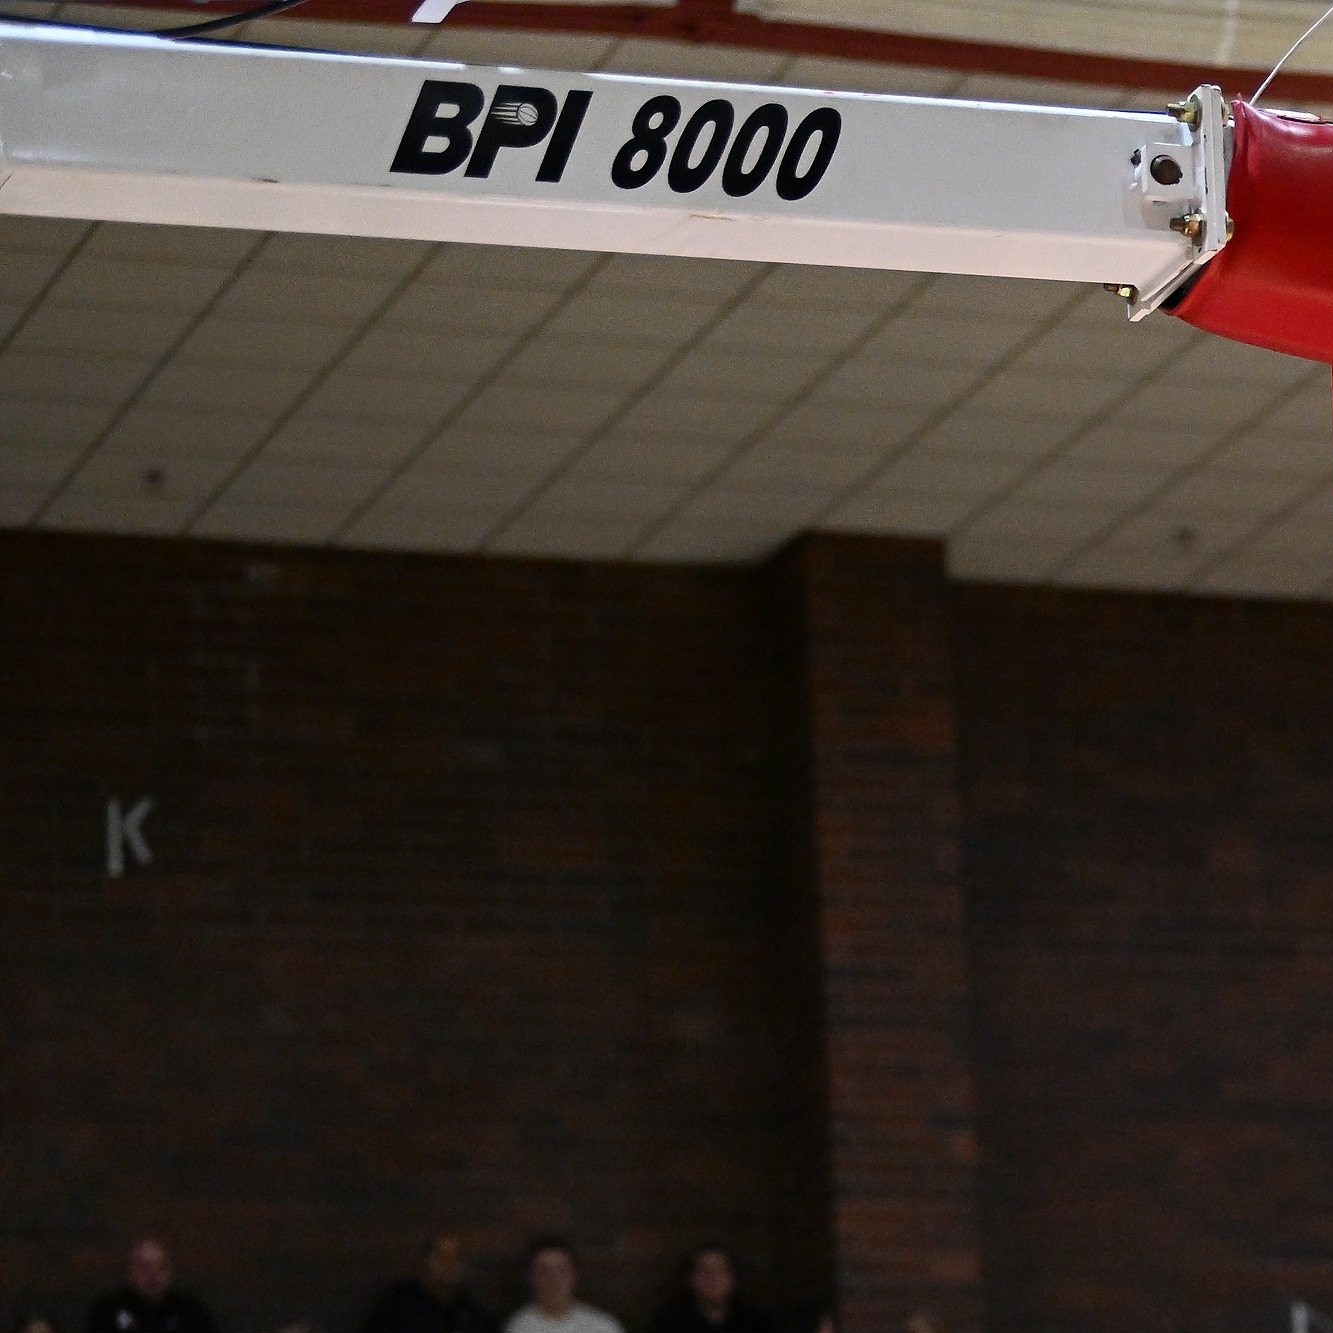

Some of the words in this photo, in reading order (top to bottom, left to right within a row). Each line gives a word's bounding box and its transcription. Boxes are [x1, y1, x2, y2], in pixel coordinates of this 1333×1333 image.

[390, 80, 594, 182] BPI
[611, 95, 842, 200] 8000
[107, 798, 153, 875] K
